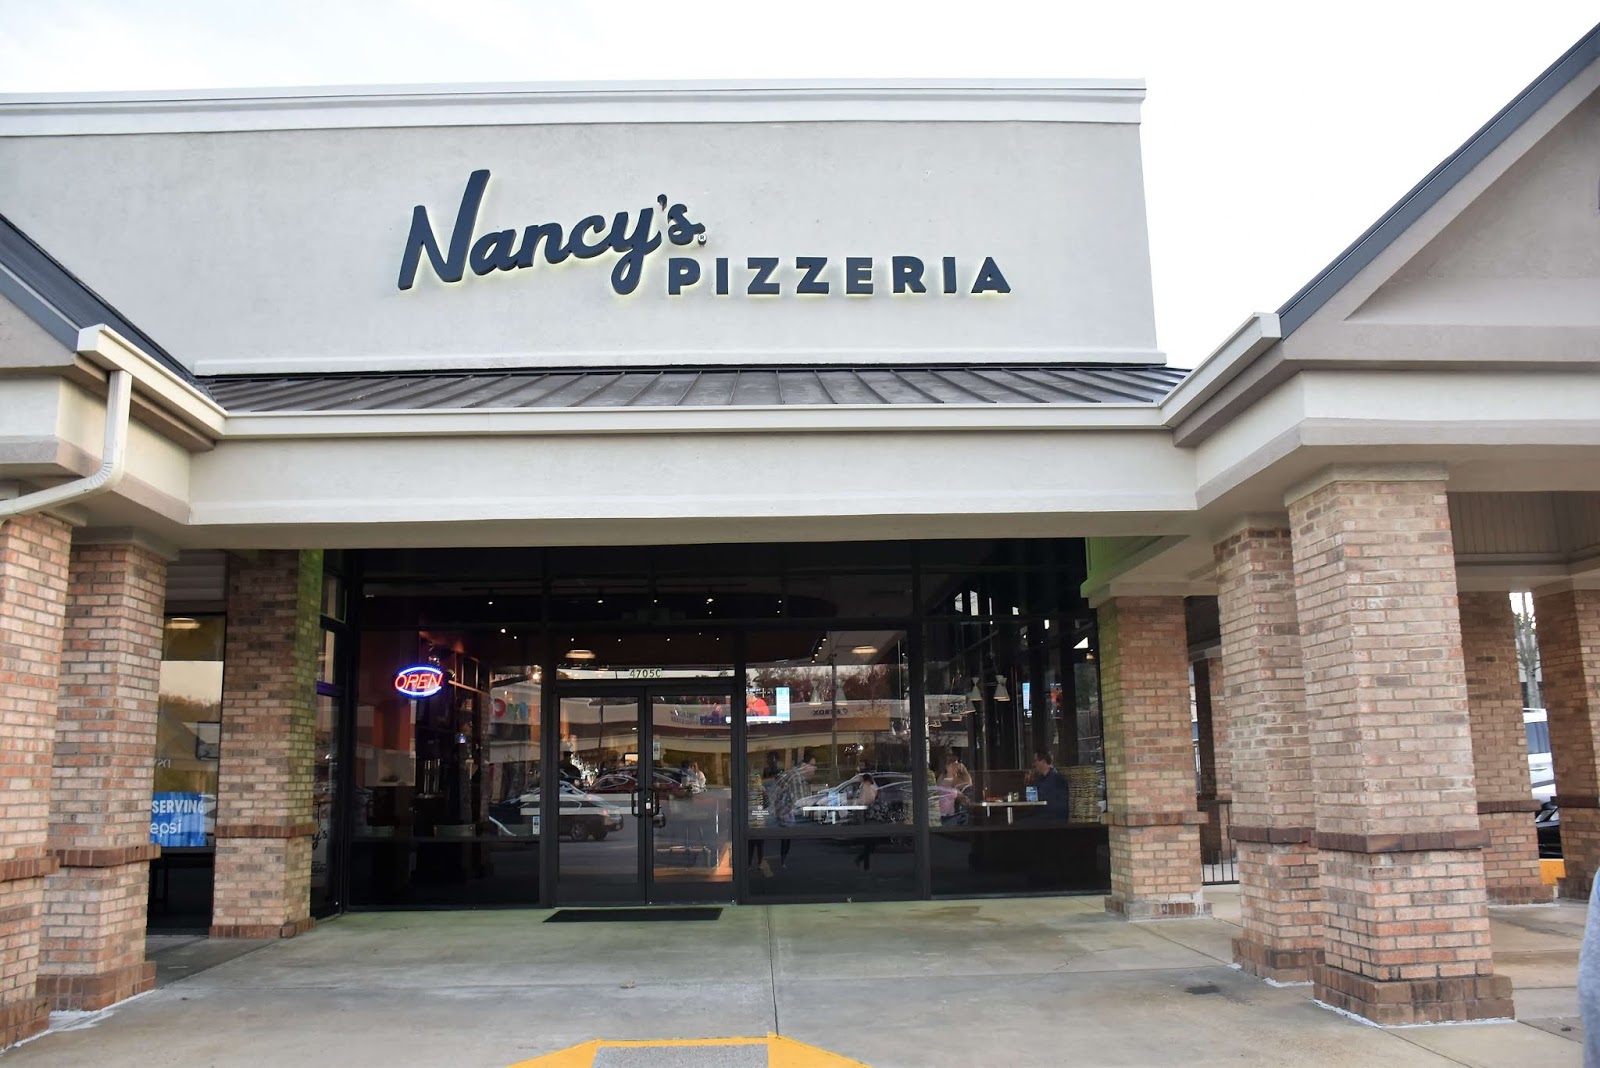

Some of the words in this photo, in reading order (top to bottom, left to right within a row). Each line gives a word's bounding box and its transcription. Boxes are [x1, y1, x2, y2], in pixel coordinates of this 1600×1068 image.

[397, 169, 706, 295] Nancy's
[668, 256, 1011, 296] PIZZERIA
[394, 673, 443, 690] OPEN
[629, 669, 662, 679] 4705C
[150, 819, 182, 838] epsi
